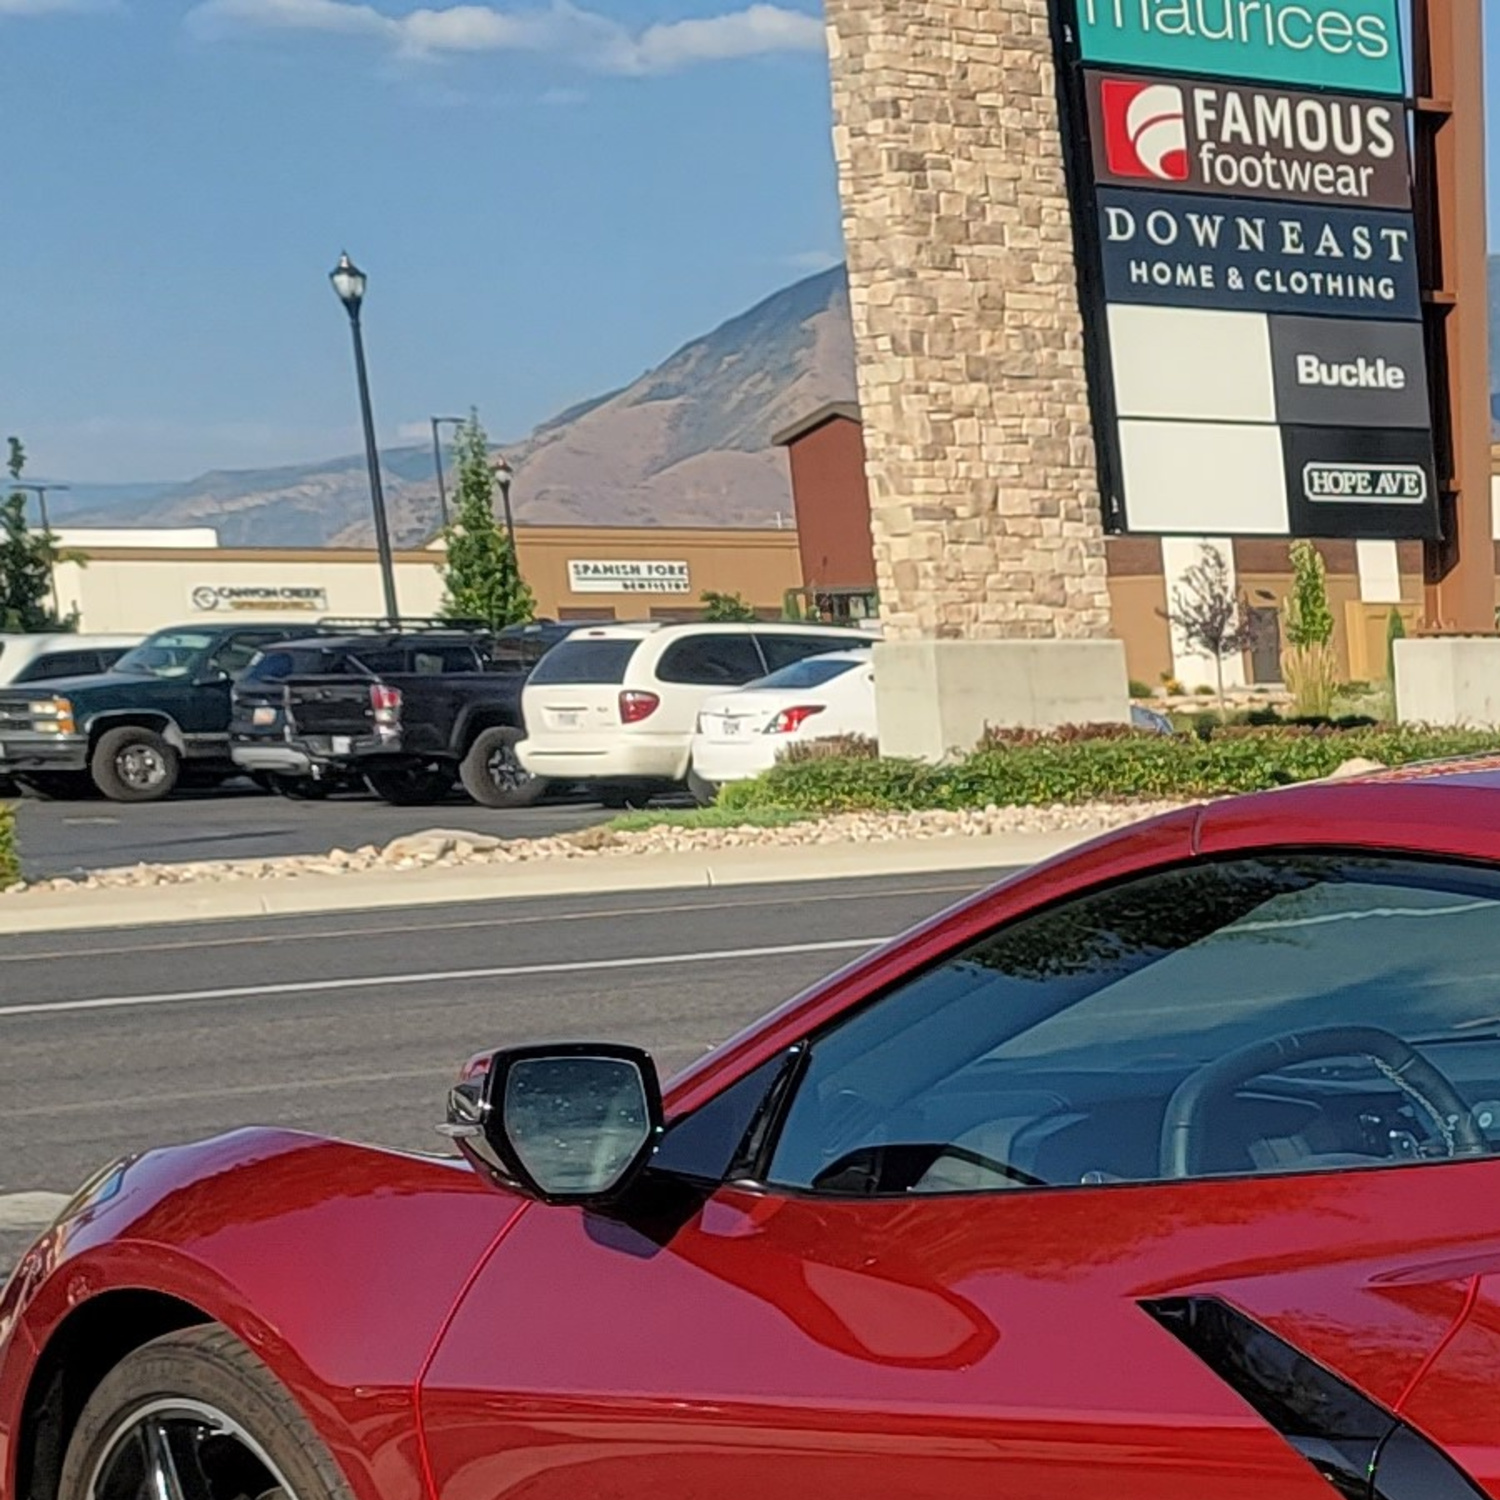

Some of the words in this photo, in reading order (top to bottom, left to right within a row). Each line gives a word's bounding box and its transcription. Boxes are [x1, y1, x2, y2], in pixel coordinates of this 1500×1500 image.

[1193, 87, 1395, 158] FAMOUS
[1199, 142, 1374, 197] footwear
[1104, 206, 1409, 262] DOWNEAST
[1129, 260, 1215, 290] HOME
[1226, 266, 1245, 291] &
[1254, 268, 1396, 300] CLOTHING
[1296, 354, 1406, 389] Buckle
[1311, 470, 1373, 495] HOPE
[1374, 472, 1420, 496] AVE
